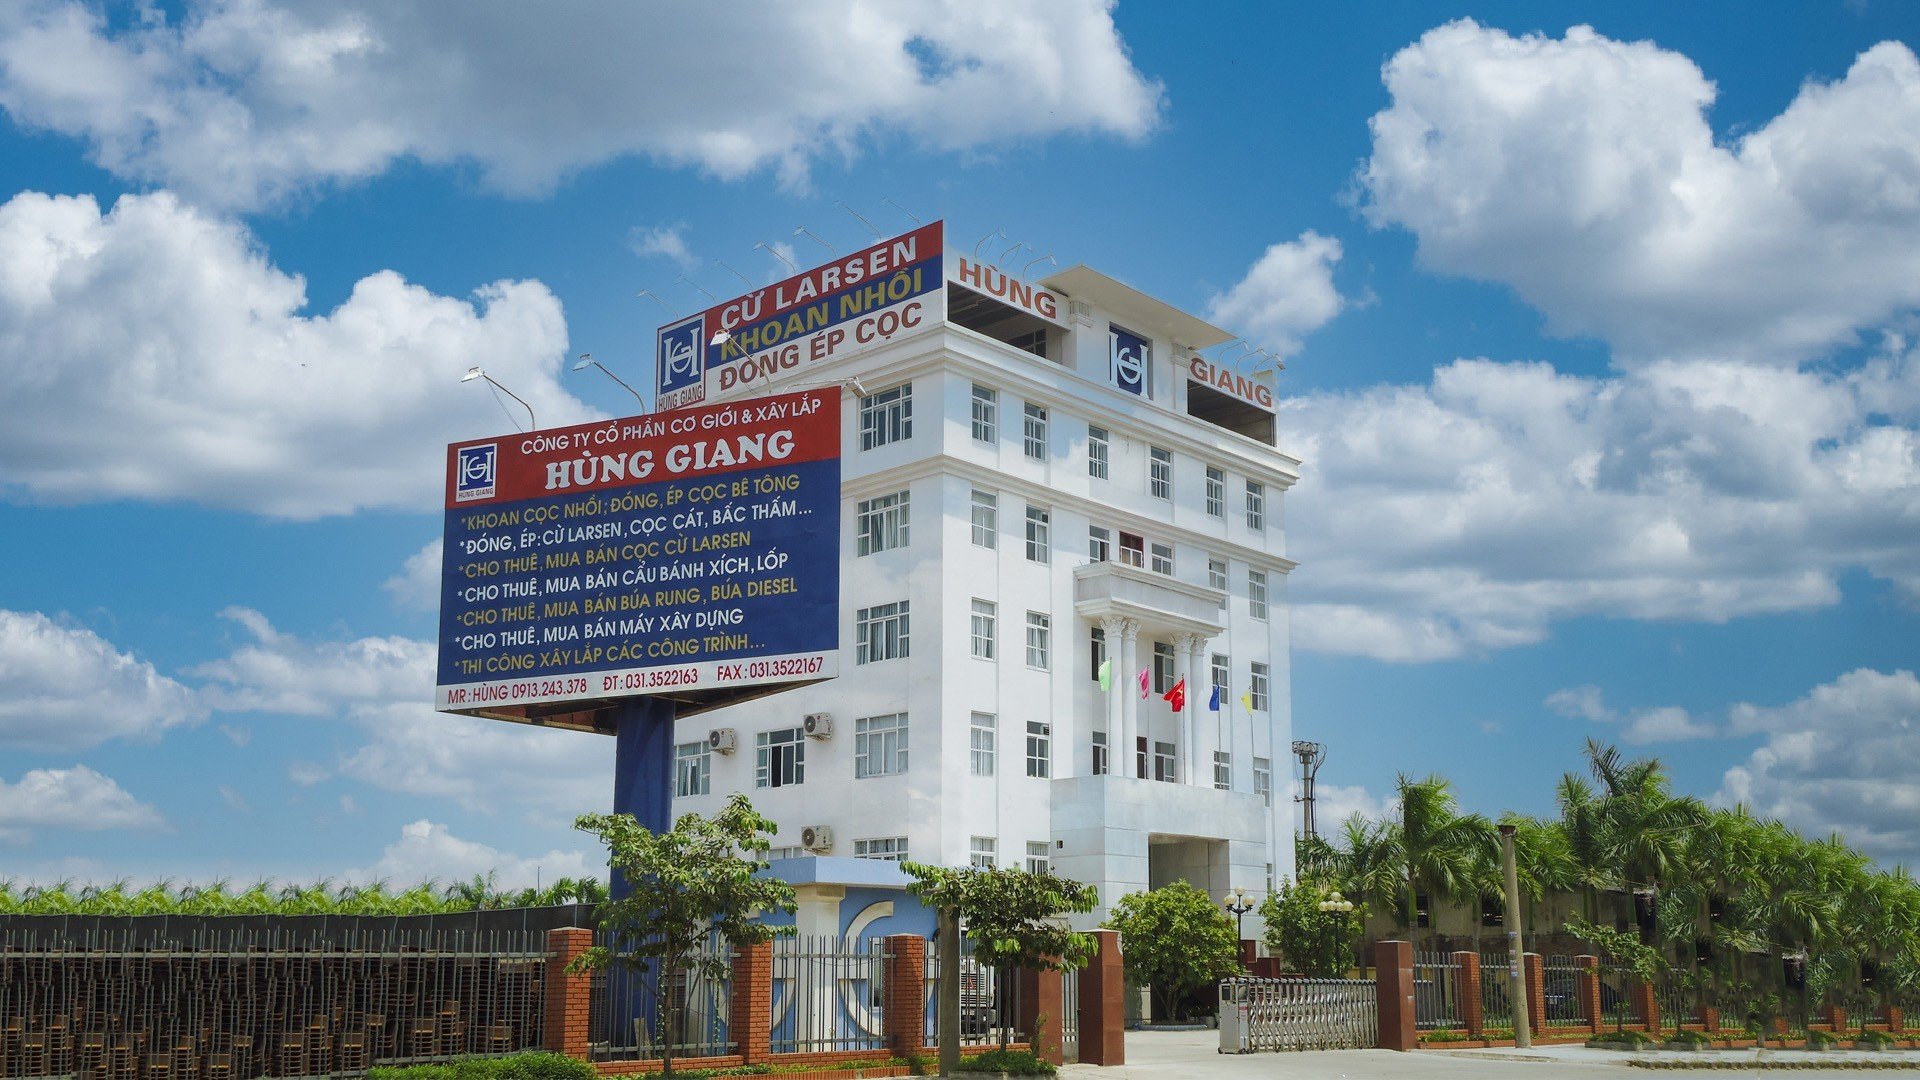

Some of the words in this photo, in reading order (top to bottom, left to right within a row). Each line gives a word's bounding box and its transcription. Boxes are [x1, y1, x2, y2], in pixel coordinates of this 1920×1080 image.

[721, 290, 765, 330] CỪ
[776, 236, 916, 310] LARSEN
[959, 257, 1056, 319] HÙNG
[721, 301, 828, 361] KHOAN
[810, 328, 845, 362] ÉP
[855, 302, 922, 344] CỌC
[680, 385, 703, 405] GIANG
[1190, 357, 1271, 408] GIANG
[521, 435, 570, 455] CÔNG
[573, 431, 592, 448] TY
[594, 420, 619, 445] CỔ
[622, 417, 665, 441] PHẦN
[670, 416, 697, 433] CƠ
[701, 405, 737, 430] GIỚI
[741, 408, 753, 424] &
[755, 401, 788, 422] XÂY
[791, 393, 822, 417] LẮP
[544, 450, 655, 490] HÙNG
[665, 429, 795, 473] GIANG
[476, 488, 494, 497] GIANG
[523, 504, 560, 525] CỌC
[666, 484, 683, 505] ÉP
[688, 483, 727, 504] CỌC
[731, 477, 749, 497] BÊ
[753, 473, 800, 493] TÔNG
[629, 516, 667, 537] CỌC
[546, 551, 581, 569] MUA
[585, 543, 618, 565] BÁN
[621, 541, 660, 562] CỌC
[664, 533, 689, 554] CỪ
[692, 530, 751, 553] LARSEN
[545, 576, 581, 594] MUA
[585, 567, 618, 590] BÁN
[622, 560, 657, 585] CẨU
[659, 558, 704, 582] BÁNH
[544, 601, 580, 618] MUA
[584, 592, 617, 614] BÁN
[620, 588, 651, 610] BÚA
[711, 578, 743, 601] BÚA
[747, 577, 798, 598] DIESEL
[543, 625, 579, 643] MUA
[584, 616, 616, 639] BÁN
[619, 612, 655, 636] MÁY
[659, 611, 692, 631] XÂY
[695, 608, 744, 630] DỰNG
[486, 652, 536, 673] CÔNG
[539, 648, 572, 668] XÂY
[574, 641, 602, 665] LẮP
[606, 640, 643, 662] CÁC
[647, 637, 699, 658] CÔNG
[511, 678, 587, 699] 0913.243.378
